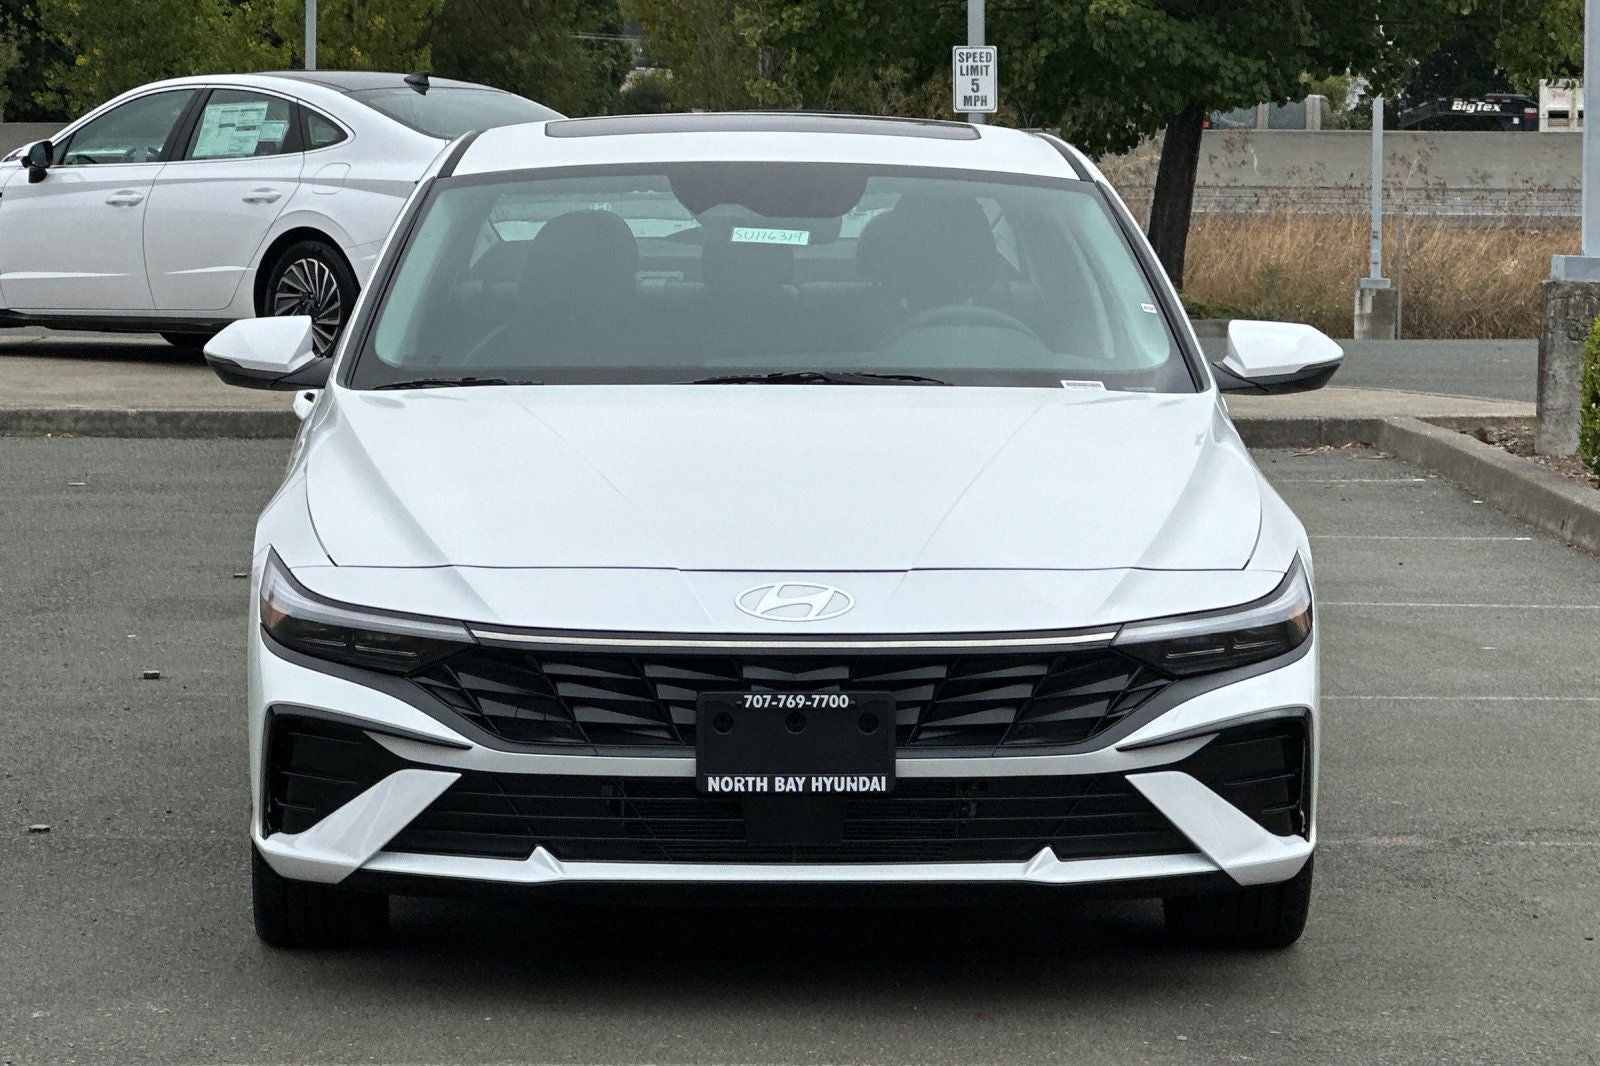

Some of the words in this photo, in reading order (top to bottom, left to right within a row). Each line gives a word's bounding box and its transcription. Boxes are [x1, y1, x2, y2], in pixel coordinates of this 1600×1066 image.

[958, 51, 992, 63] SPEED
[960, 65, 990, 76] LIMIT
[971, 78, 980, 93] 5
[963, 95, 987, 106] MPH
[743, 694, 850, 709] 707-769-7700
[707, 776, 768, 792] NORTH
[774, 776, 806, 792] BAY
[811, 776, 887, 792] HYUNDAI
